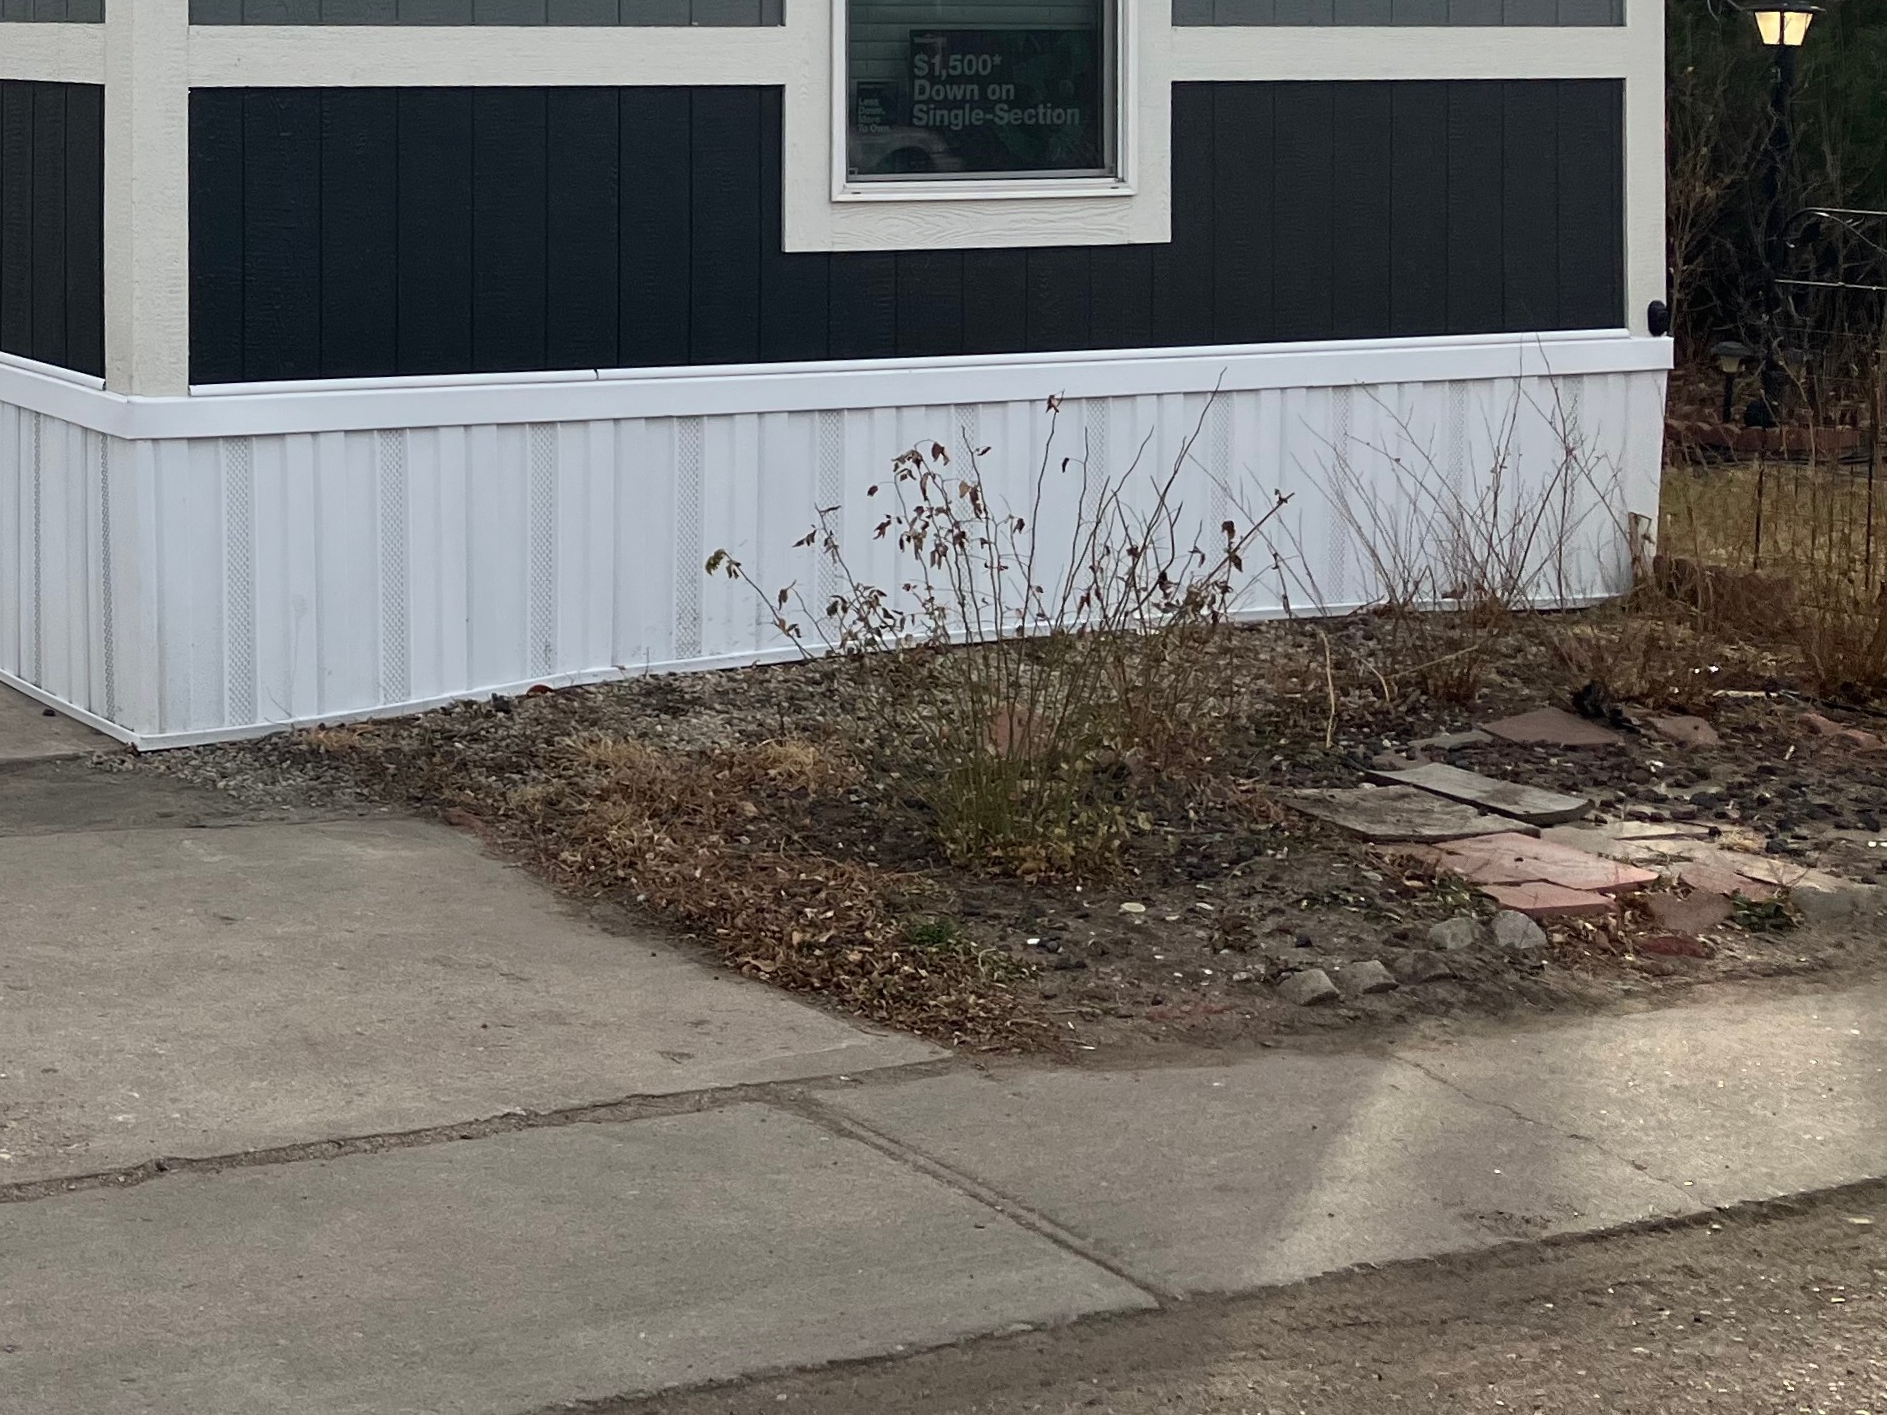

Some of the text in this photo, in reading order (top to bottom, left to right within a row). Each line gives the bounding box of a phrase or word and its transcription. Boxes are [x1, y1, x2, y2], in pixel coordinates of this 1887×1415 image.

[913, 80, 1015, 101] Down on
[912, 103, 1080, 131] Single-Section
